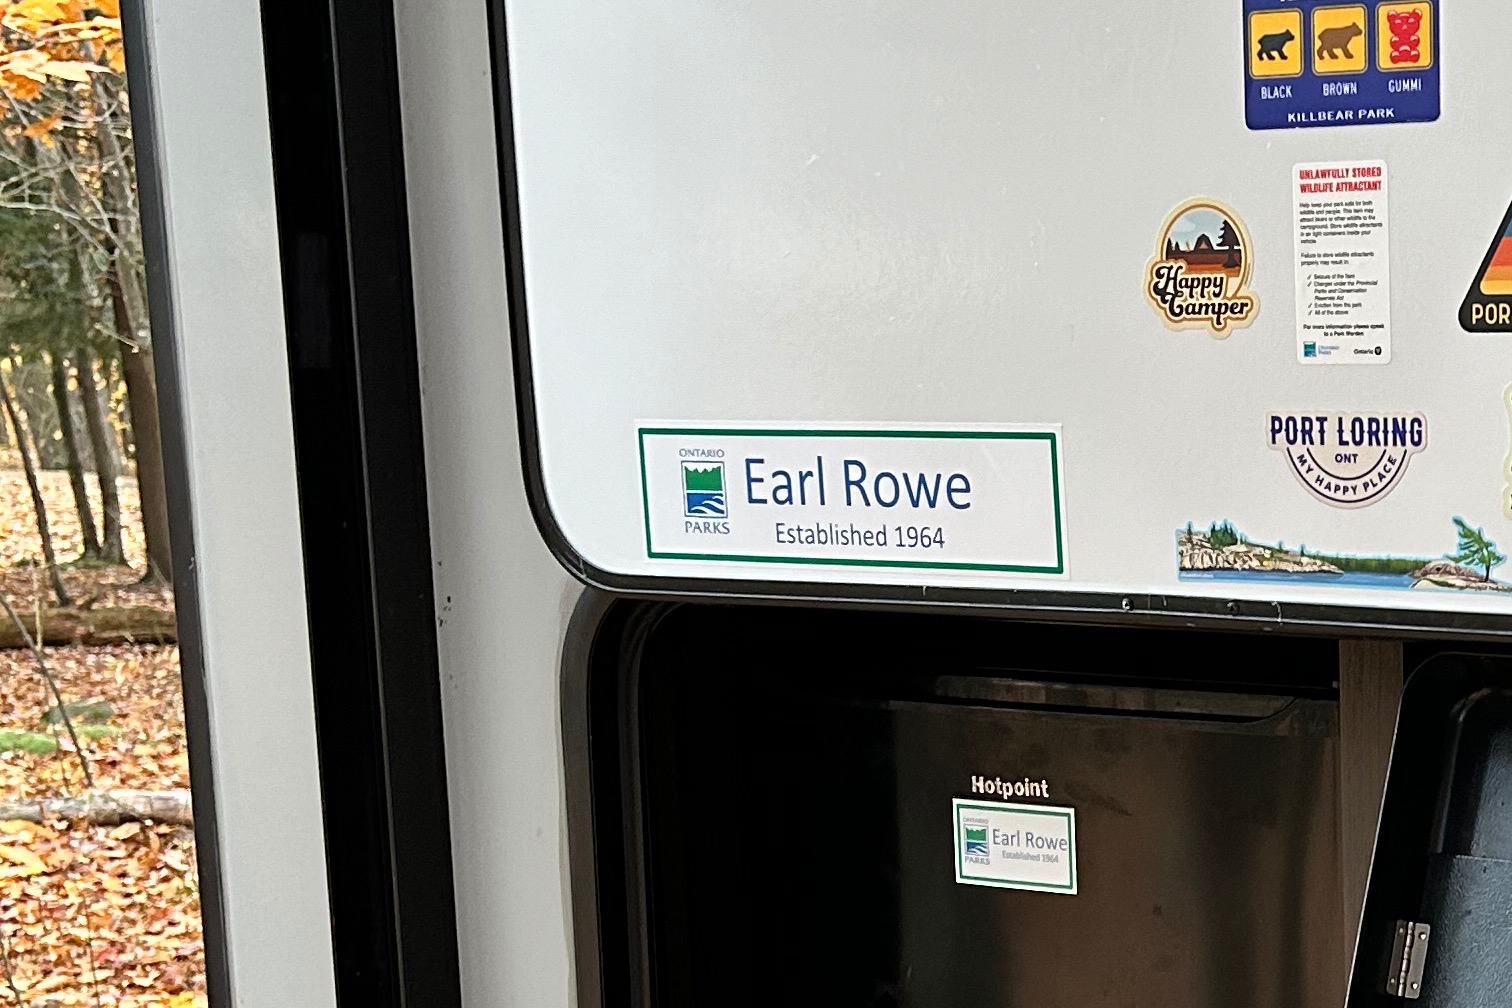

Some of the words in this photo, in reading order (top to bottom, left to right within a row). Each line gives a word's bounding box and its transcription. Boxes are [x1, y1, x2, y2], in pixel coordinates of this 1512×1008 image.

[1261, 85, 1292, 99] BLACK
[1322, 81, 1358, 97] BROWN
[1388, 78, 1422, 93] GUMMI
[1287, 110, 1354, 123] KILLBEAR
[1358, 108, 1395, 120] PARK
[1299, 168, 1349, 179] UNLAWFULLY
[1300, 182, 1333, 193] WILDLIFE
[1336, 180, 1381, 192] ATTRACTANT
[1154, 265, 1224, 298] Happy
[1158, 290, 1249, 325] Camper
[1270, 416, 1328, 445] PORT
[1337, 417, 1423, 447] LORING
[679, 448, 725, 458] ONTARIO
[1335, 453, 1358, 463] ONT
[1297, 454, 1314, 474] MY
[1315, 475, 1358, 495] HAPPY
[1362, 454, 1398, 492] PLACE
[745, 456, 826, 506] Earl
[843, 459, 972, 510] Rowe
[684, 521, 730, 535] PARKS
[775, 522, 888, 547] Established
[895, 527, 945, 549] 1964
[971, 775, 1049, 800] Hotpoint
[992, 828, 1020, 847] Earl
[1026, 831, 1067, 851] Rowe
